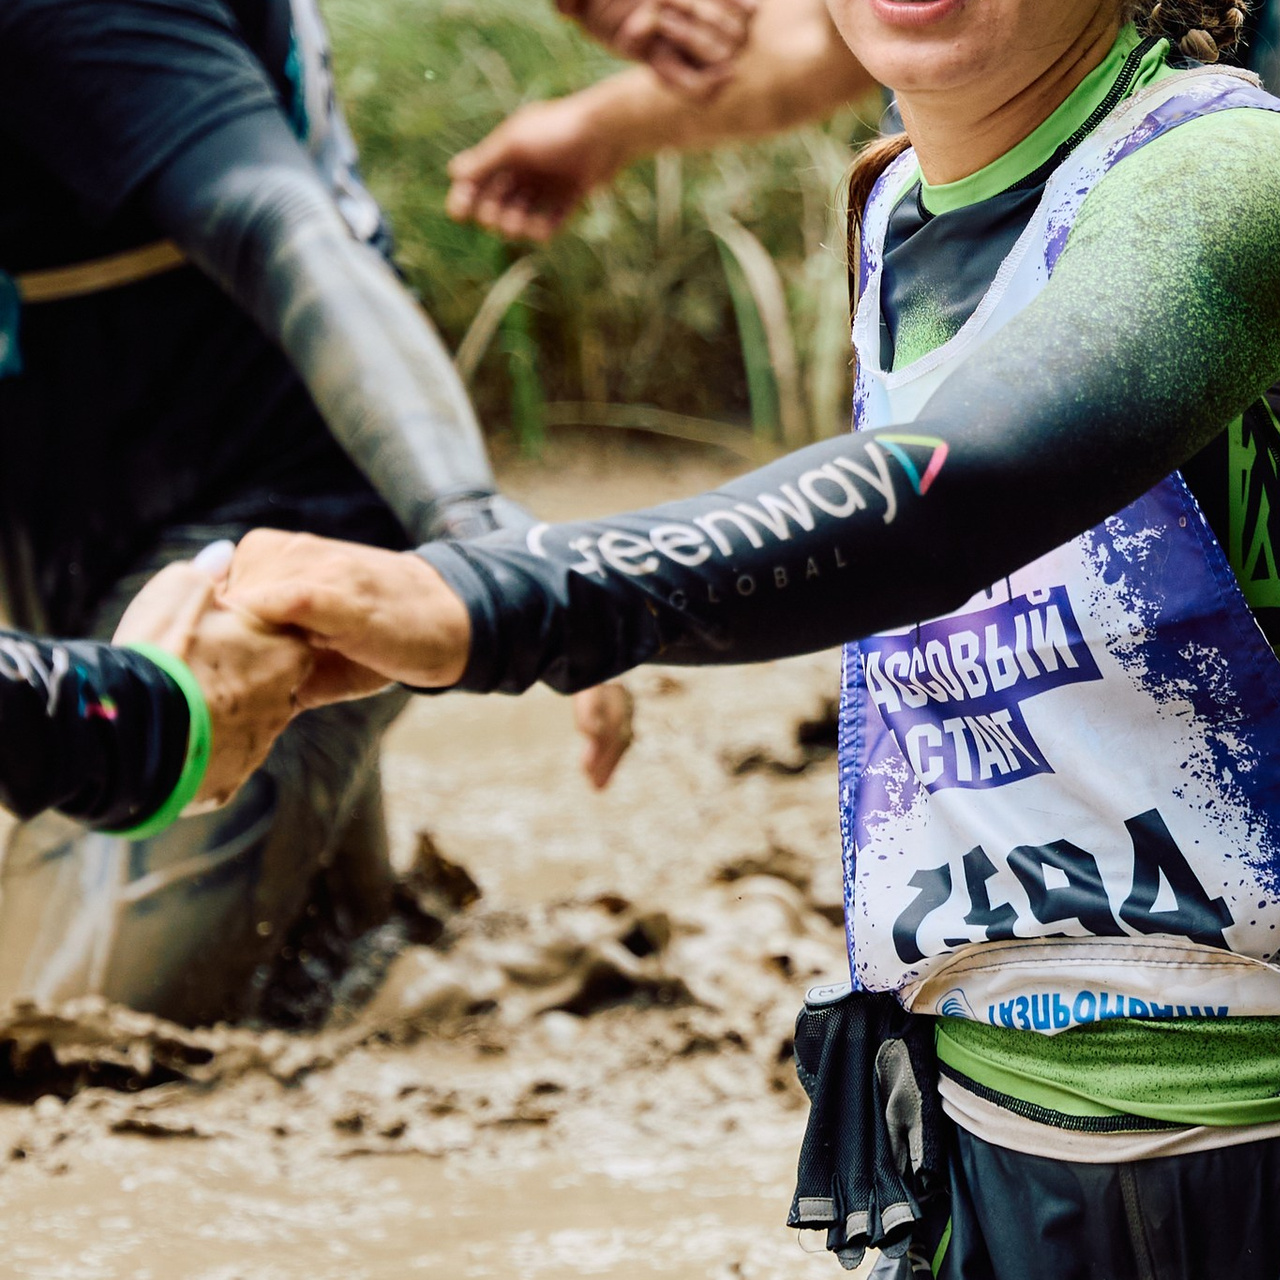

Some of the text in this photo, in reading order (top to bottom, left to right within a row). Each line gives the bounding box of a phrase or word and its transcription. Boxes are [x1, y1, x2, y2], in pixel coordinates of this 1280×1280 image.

[668, 546, 849, 611] GLOBAL
[861, 586, 1080, 713] АССОВЫЙ
[905, 708, 1040, 786] СТАРТ
